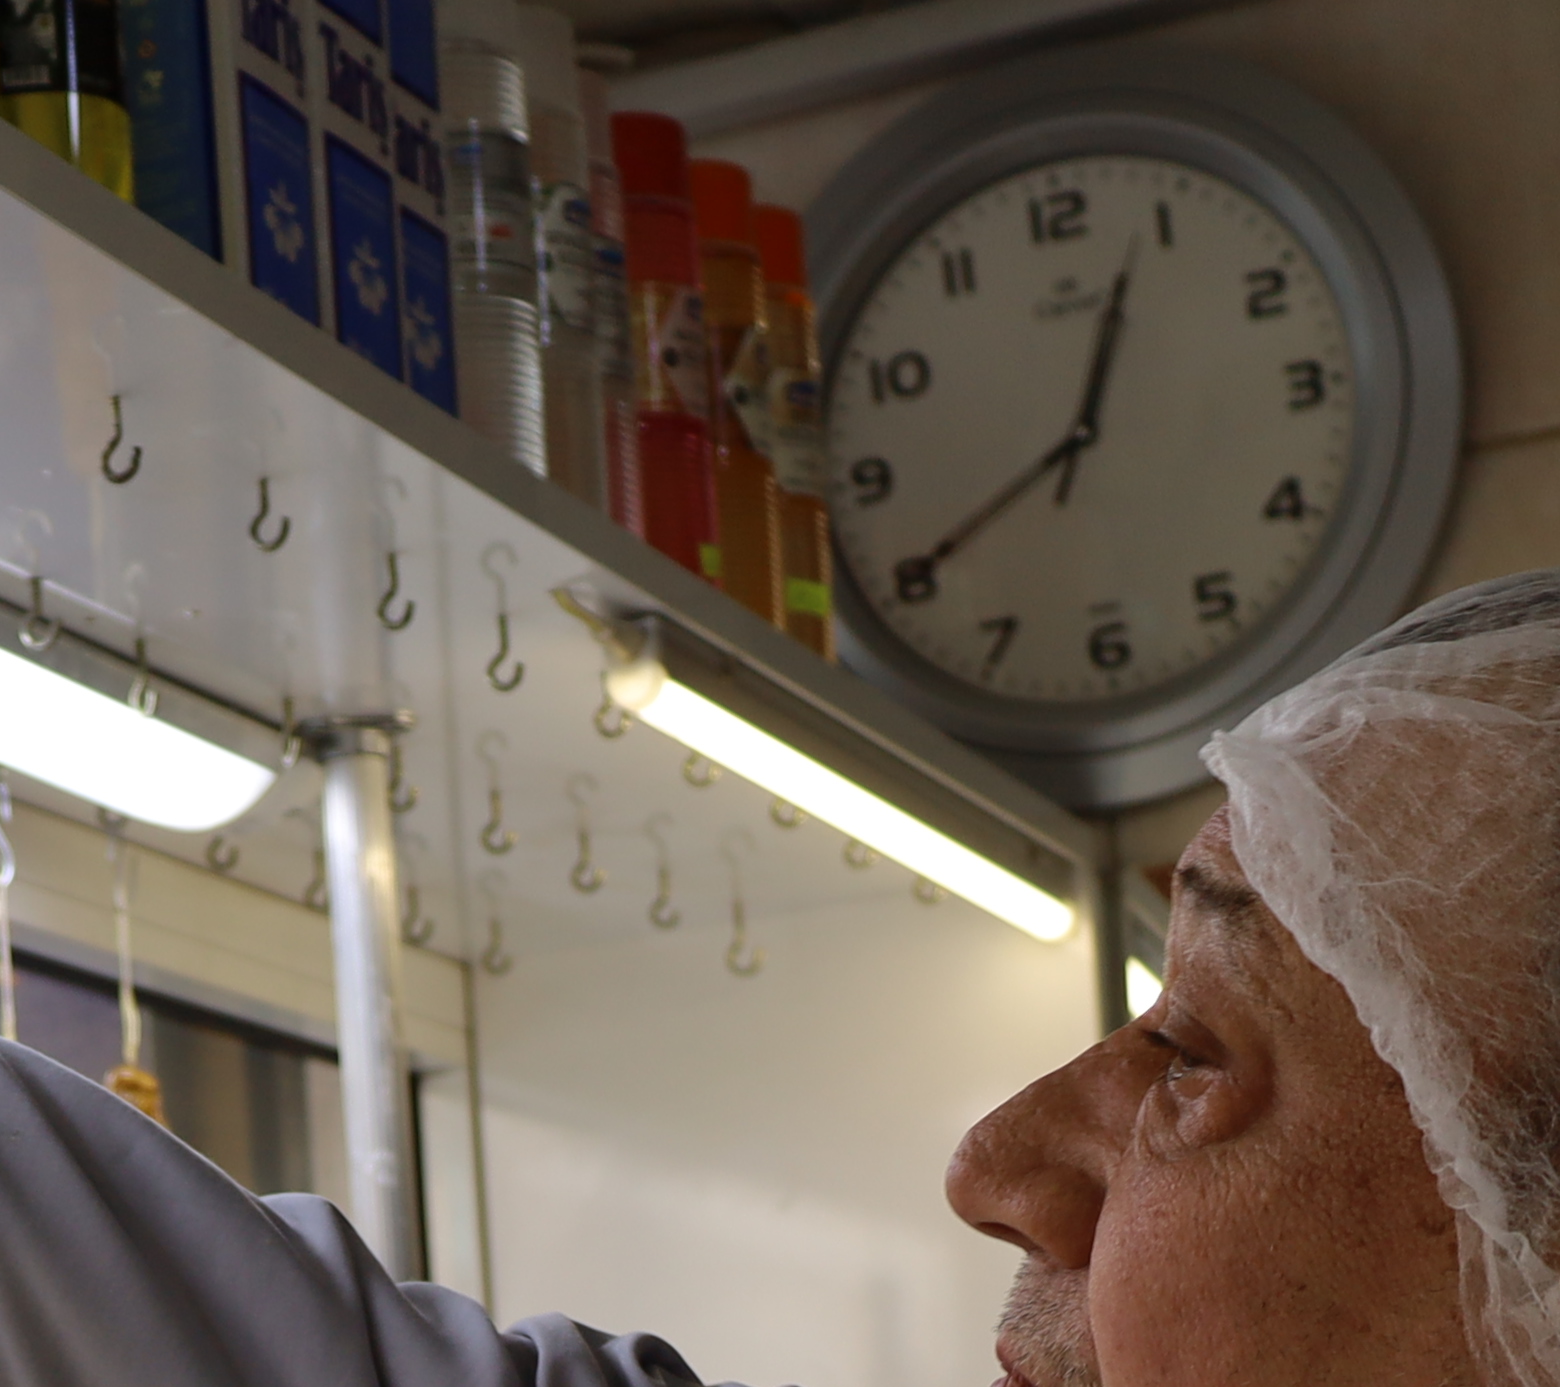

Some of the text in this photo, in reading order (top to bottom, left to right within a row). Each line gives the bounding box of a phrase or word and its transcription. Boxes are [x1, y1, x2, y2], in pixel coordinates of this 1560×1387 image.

[1027, 189, 1089, 246] 12
[1154, 202, 1174, 246] 1
[942, 247, 977, 298] 11
[1246, 267, 1289, 319] 2
[867, 350, 931, 404] 10
[1283, 358, 1325, 410] 3
[850, 456, 893, 506] 9
[1262, 476, 1305, 522] 4
[894, 556, 938, 604] 8
[1194, 571, 1236, 621] 5
[978, 616, 1022, 668] 7
[1087, 621, 1131, 671] 6
